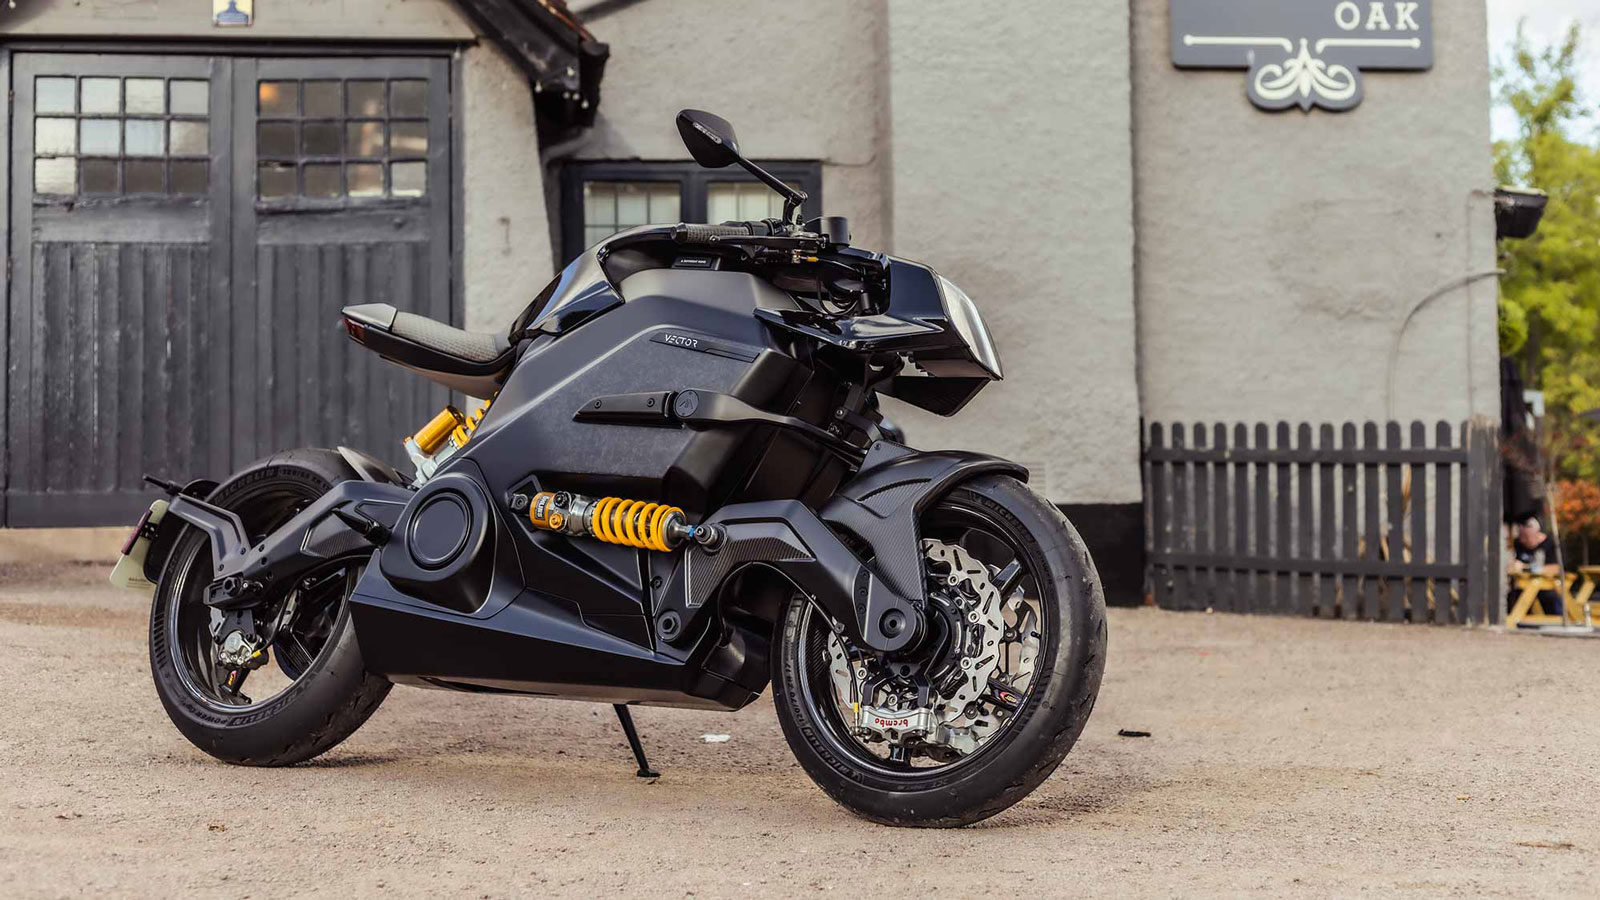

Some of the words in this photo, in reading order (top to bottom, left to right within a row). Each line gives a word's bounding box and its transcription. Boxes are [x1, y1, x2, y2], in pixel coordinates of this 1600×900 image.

[1334, 1, 1419, 31] OAK
[665, 334, 698, 348] VECTOR
[874, 718, 909, 728] brembo
[803, 728, 850, 774] MICHELIN
